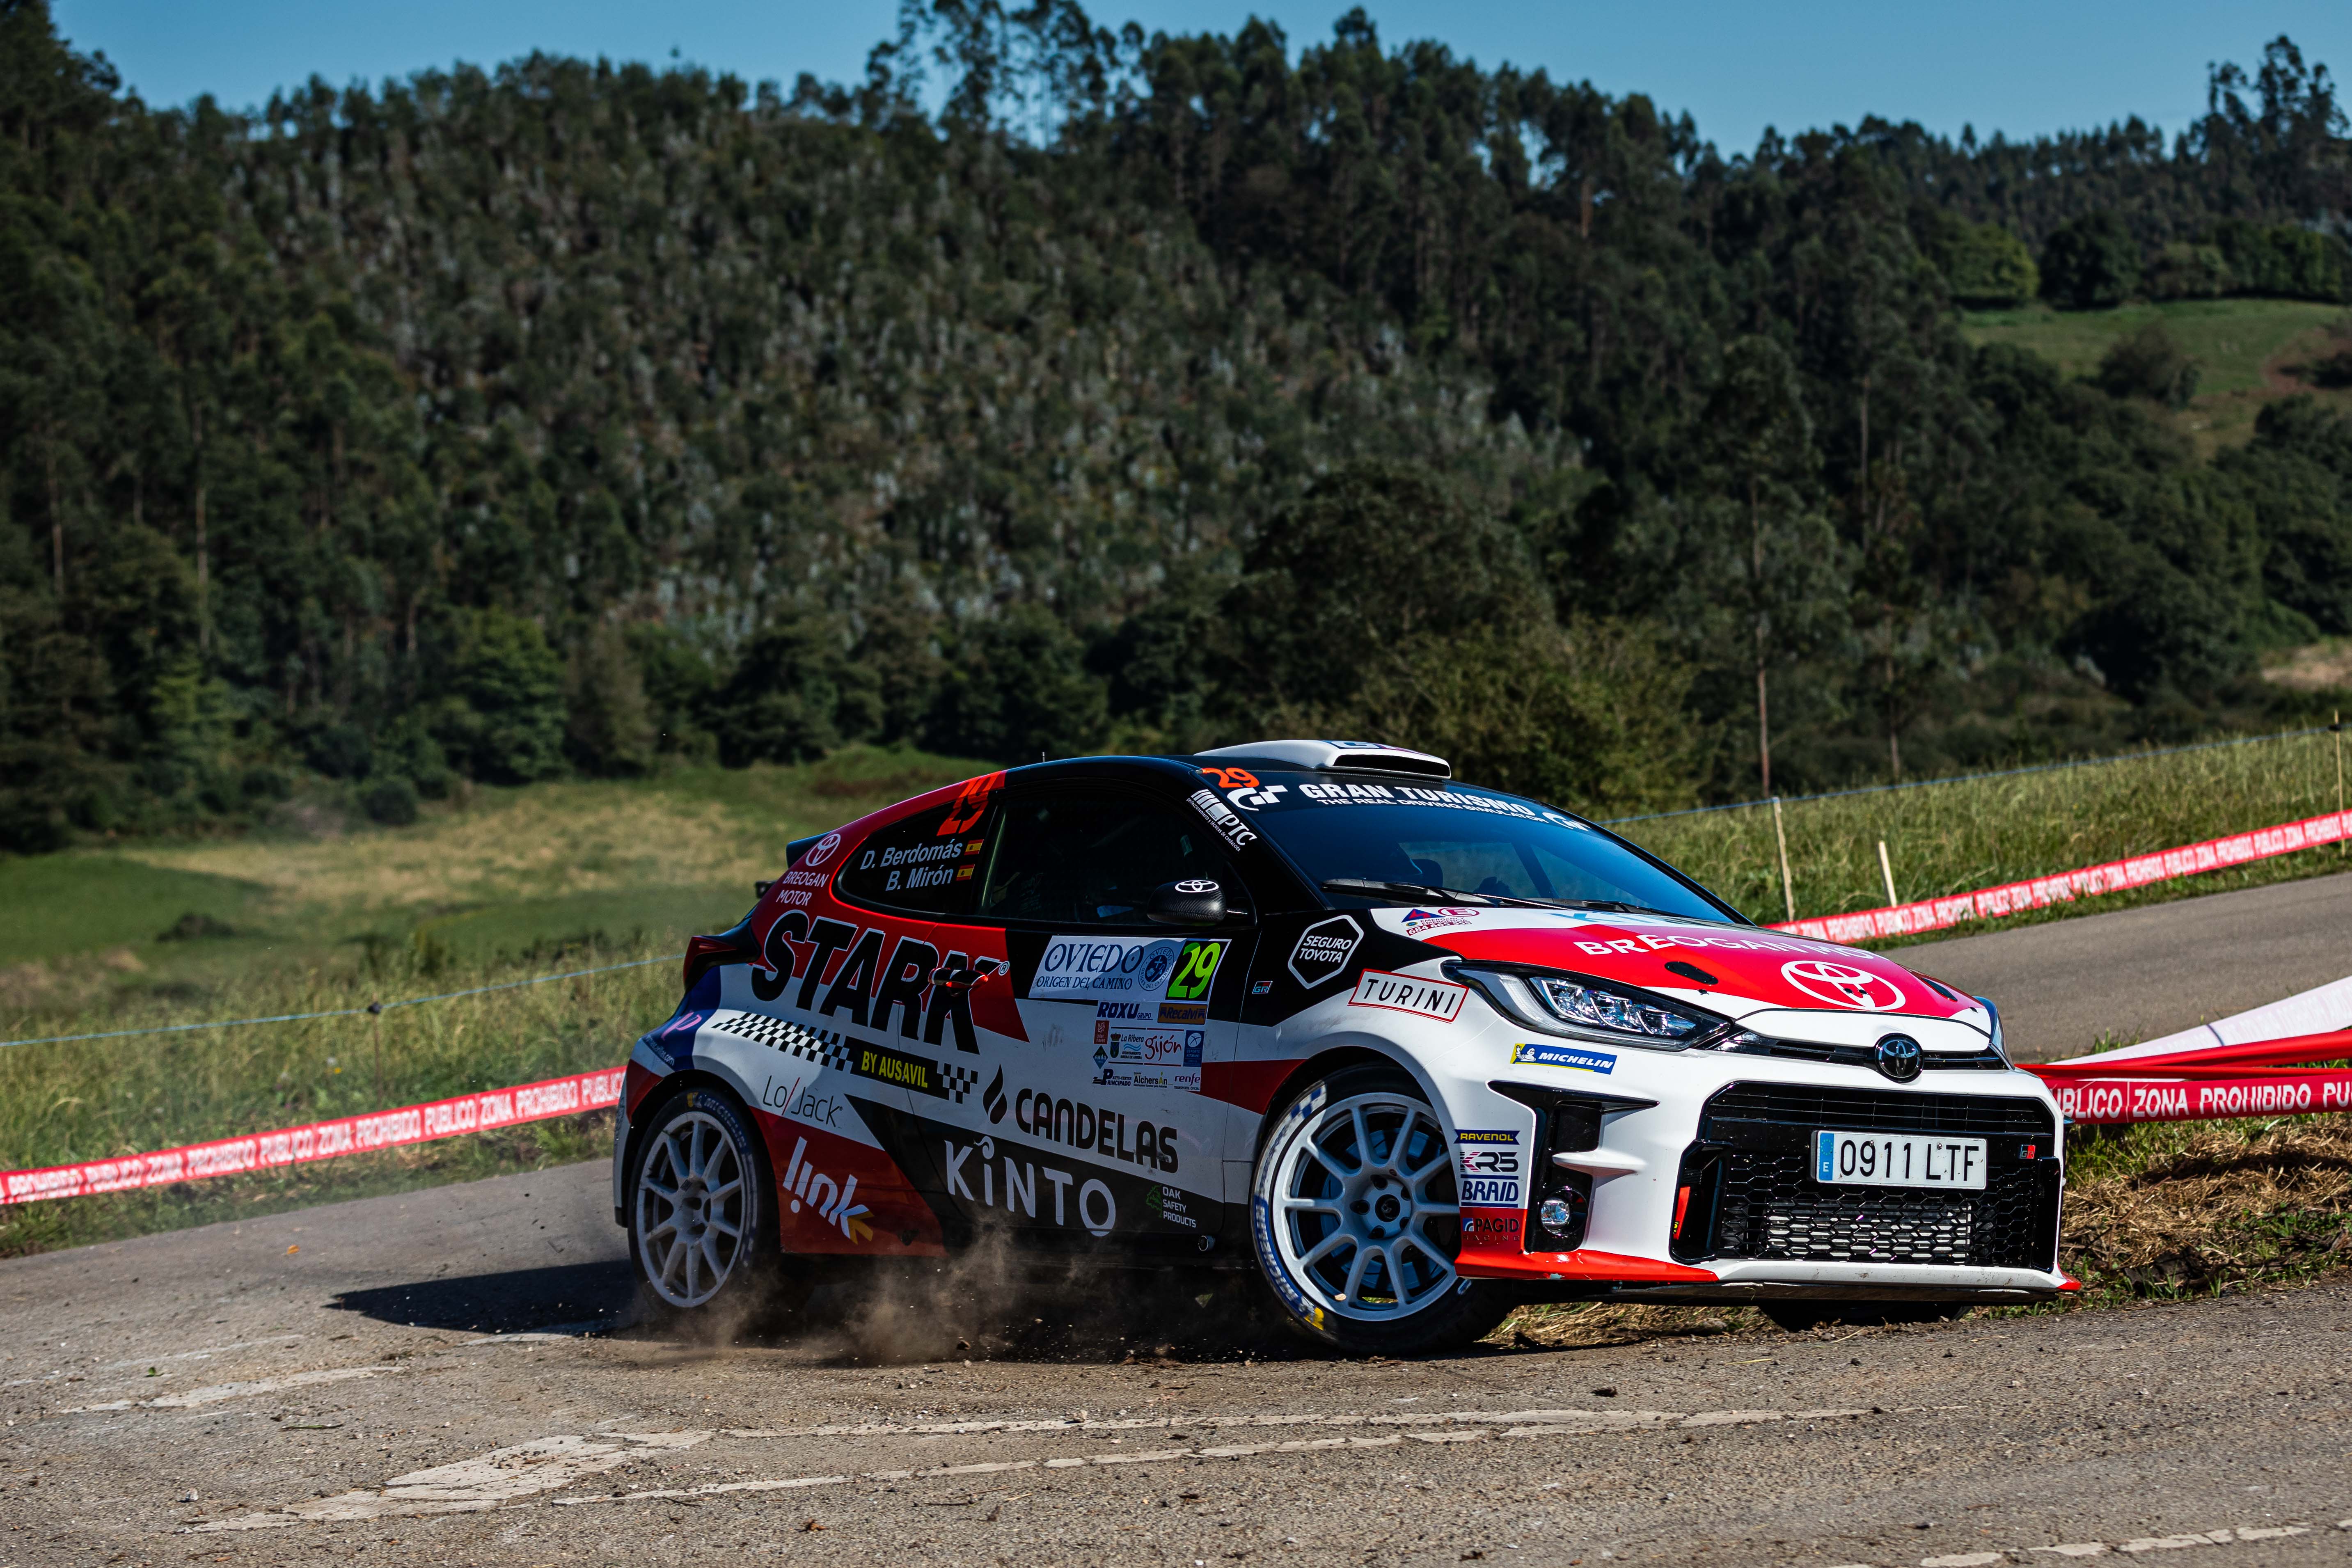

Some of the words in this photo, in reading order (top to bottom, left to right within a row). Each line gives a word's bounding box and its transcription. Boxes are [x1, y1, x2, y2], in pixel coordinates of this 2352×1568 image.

[1202, 767, 1260, 788] 29
[1186, 797, 1209, 820] perfeccionamiento
[1299, 784, 1395, 799] GRAN
[1394, 786, 1535, 816] TURISMO
[1399, 799, 1463, 809] DRIVING
[1463, 806, 1549, 824] SIMULATOR
[1217, 814, 1257, 845] PTC
[860, 850, 875, 870] D.
[880, 838, 963, 867] Berdomás
[783, 871, 829, 888] BREOGAN
[885, 871, 901, 891] B.
[906, 865, 953, 889] Mirón
[776, 890, 812, 906] MOTOR
[1409, 925, 1429, 934] 684
[1303, 936, 1352, 950] SEGURO
[1573, 934, 1809, 955] BREOGAN
[1044, 943, 1145, 973] OVIEDO
[1150, 948, 1173, 961] OVIEDO
[1299, 948, 1343, 963] TOYOTA
[1168, 943, 1221, 998] 29
[751, 909, 1002, 1055] STARK
[1036, 976, 1072, 988] ORIGEN
[1072, 977, 1092, 990] DEL
[1091, 977, 1133, 990] CAMINO
[1364, 979, 1456, 1014] TURINI
[1097, 1002, 1140, 1019] ROXU
[1167, 1007, 1197, 1020] Recalvi
[1121, 1034, 1127, 1042] La
[1128, 1035, 1144, 1043] Ribera
[1145, 1035, 1182, 1061] gijón
[861, 1051, 878, 1072] BY
[879, 1056, 928, 1088] AUSAVIL
[1538, 1052, 1613, 1069] MICHELIN
[581, 1073, 626, 1106] PUBLIC
[1174, 1073, 1200, 1086] renfe
[2132, 1088, 2189, 1118] ZONA
[2199, 1083, 2311, 1114] PROHIBIDO
[1015, 1088, 1179, 1174] CANDELAS
[1460, 1133, 1514, 1141] RAVENOL
[1823, 1162, 1829, 1172] E
[1840, 1139, 1912, 1179] 0911
[1926, 1143, 1979, 1181] LTF
[1162, 1187, 1181, 1200] OAK
[1461, 1181, 1518, 1202] BRAID
[1163, 1202, 1186, 1213] SAFETY
[1163, 1212, 1196, 1228] PRODUCTS
[1475, 1218, 1520, 1232] PAGID
